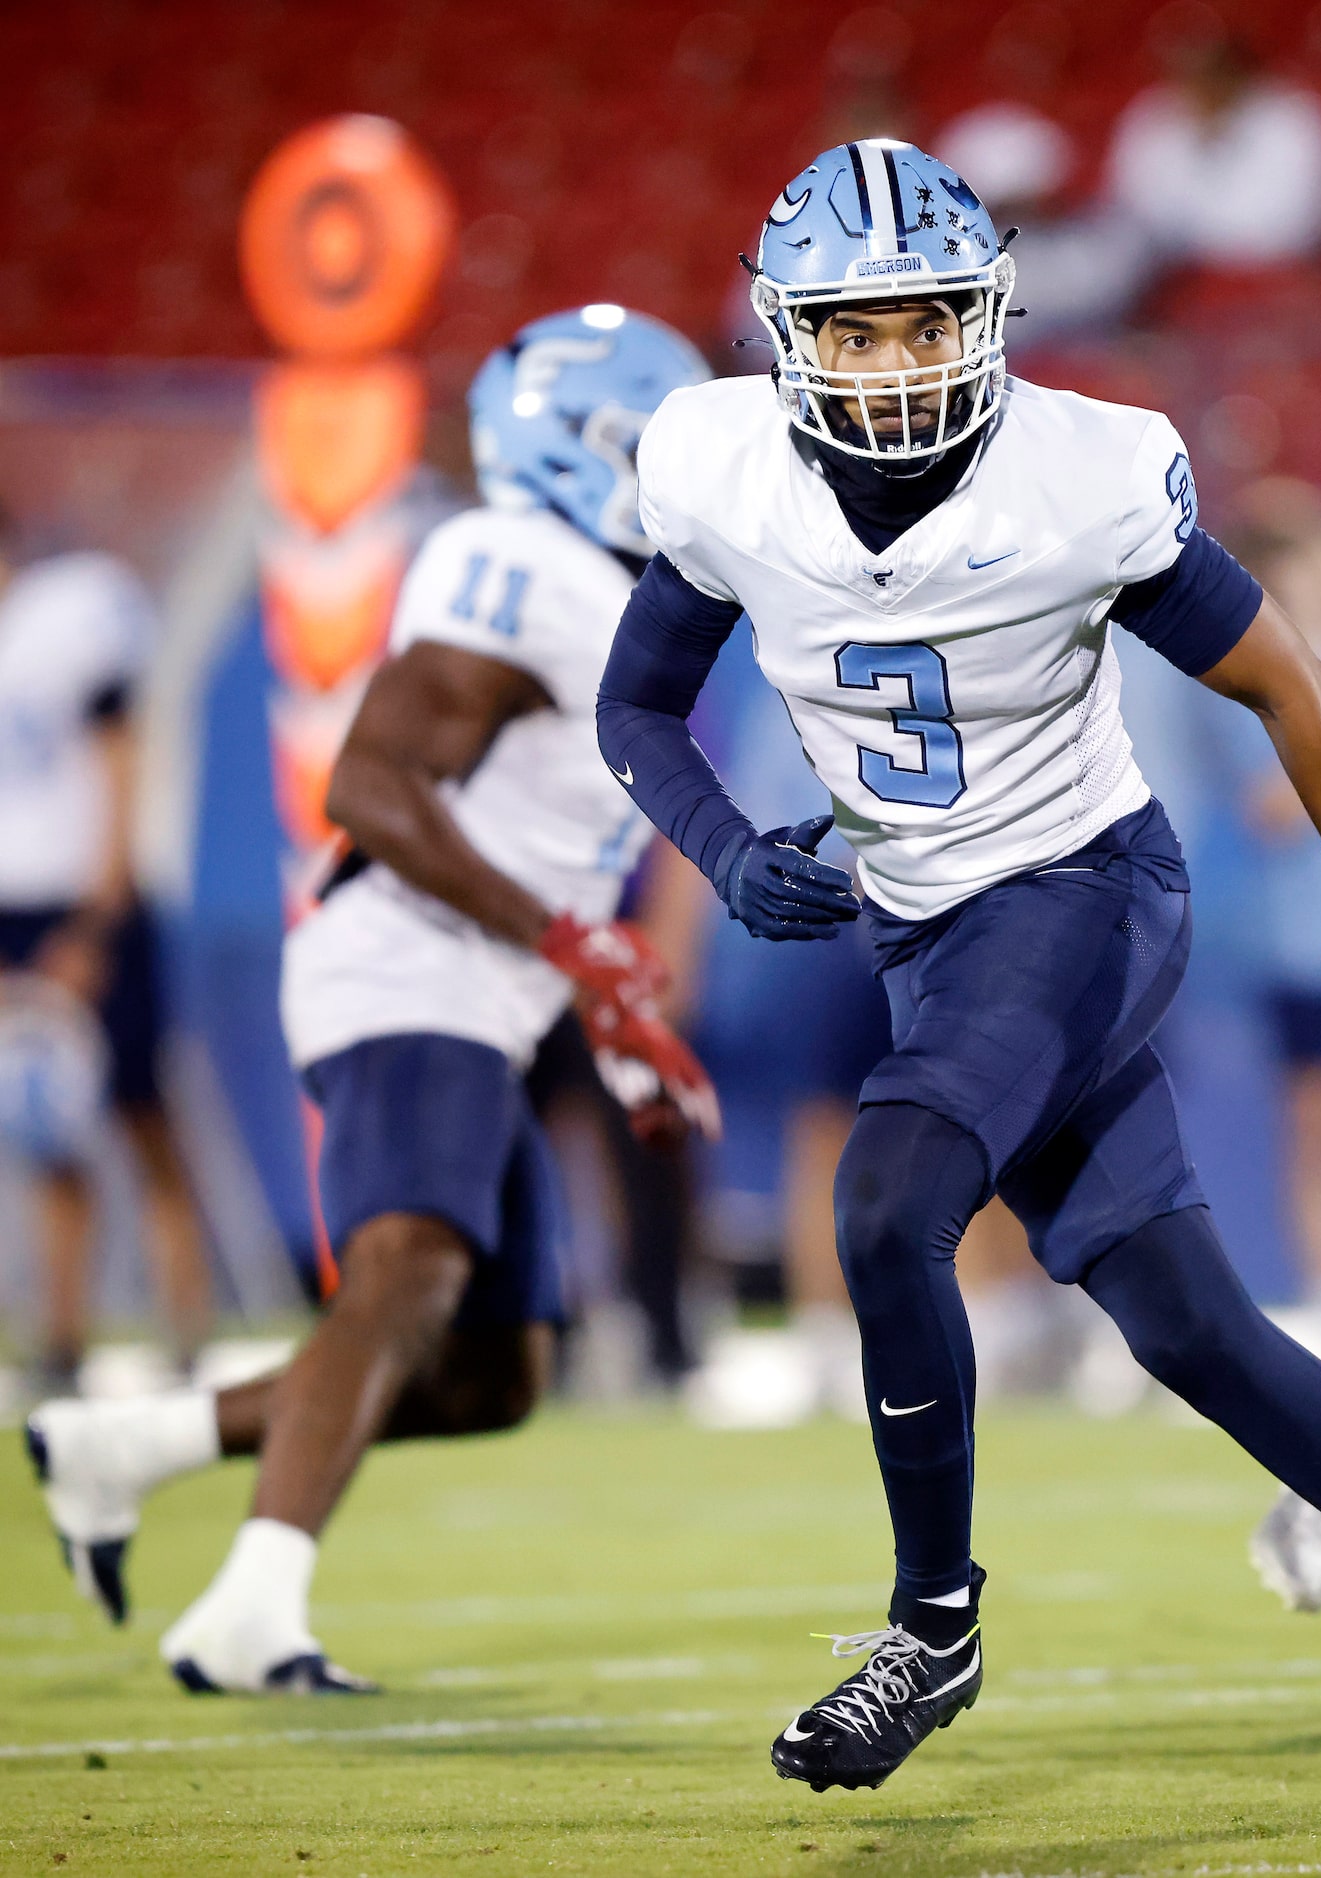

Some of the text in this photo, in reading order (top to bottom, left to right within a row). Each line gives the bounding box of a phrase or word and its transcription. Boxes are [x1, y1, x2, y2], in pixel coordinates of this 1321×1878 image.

[856, 257, 923, 277] EMERSON
[1165, 452, 1198, 544] 3
[450, 552, 532, 638] 11
[834, 640, 968, 809] 3
